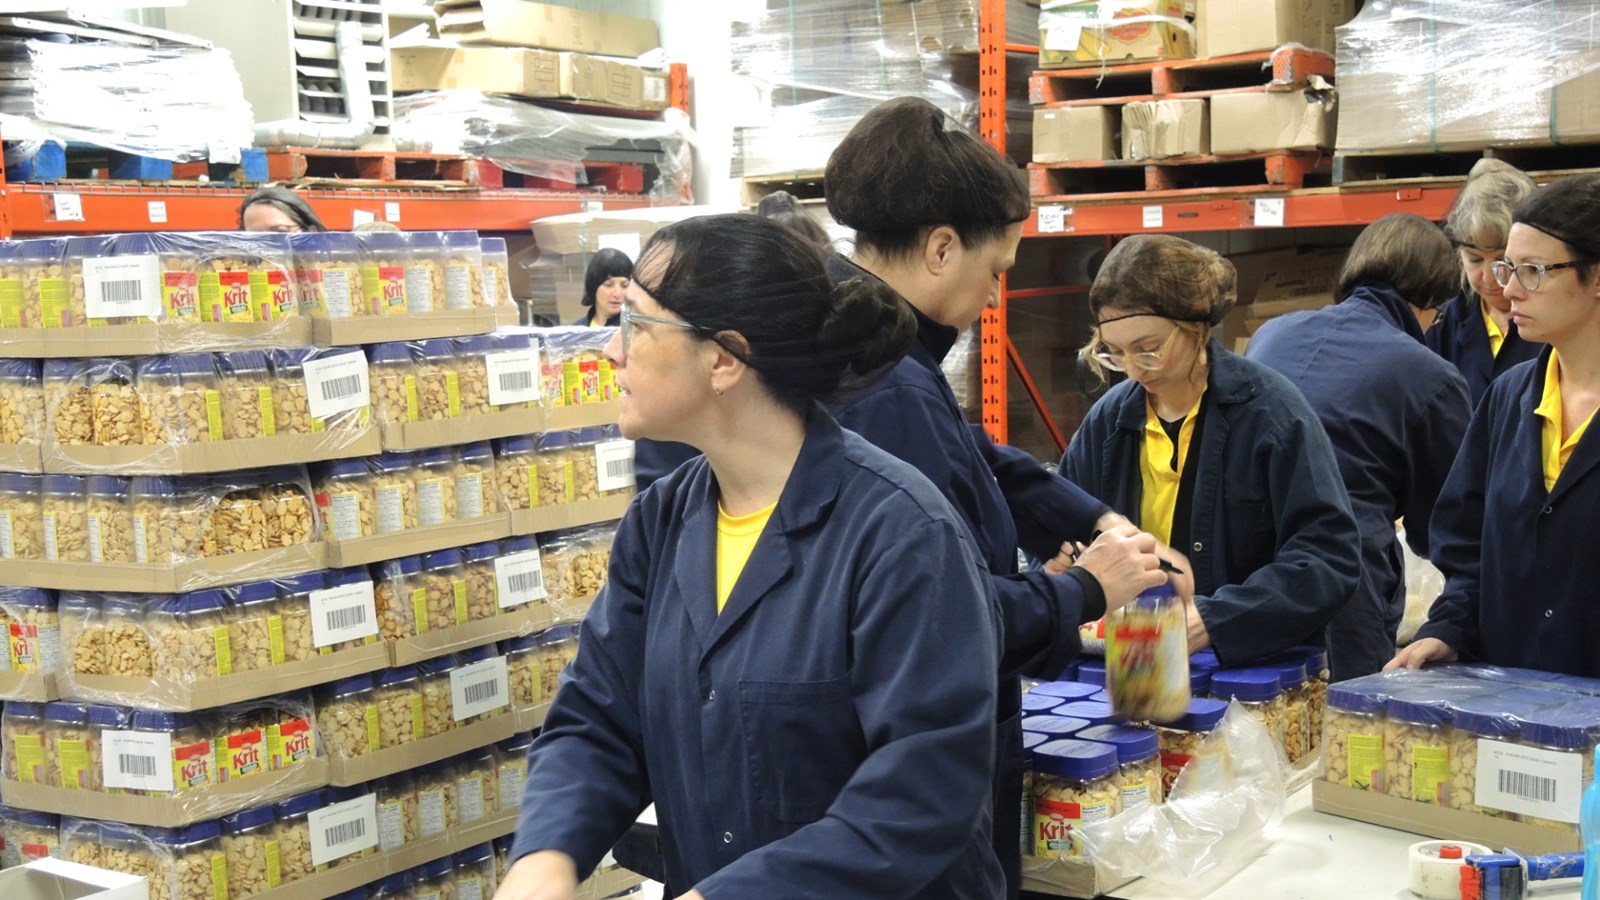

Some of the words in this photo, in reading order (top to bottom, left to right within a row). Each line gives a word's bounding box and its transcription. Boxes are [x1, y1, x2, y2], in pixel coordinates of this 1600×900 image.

[170, 288, 195, 310] Krit
[224, 287, 248, 308] Krit
[383, 282, 403, 300] Krit
[285, 735, 310, 756] Krit
[233, 747, 259, 770] Krit
[181, 759, 208, 782] Krit
[1040, 820, 1074, 842] Krit
